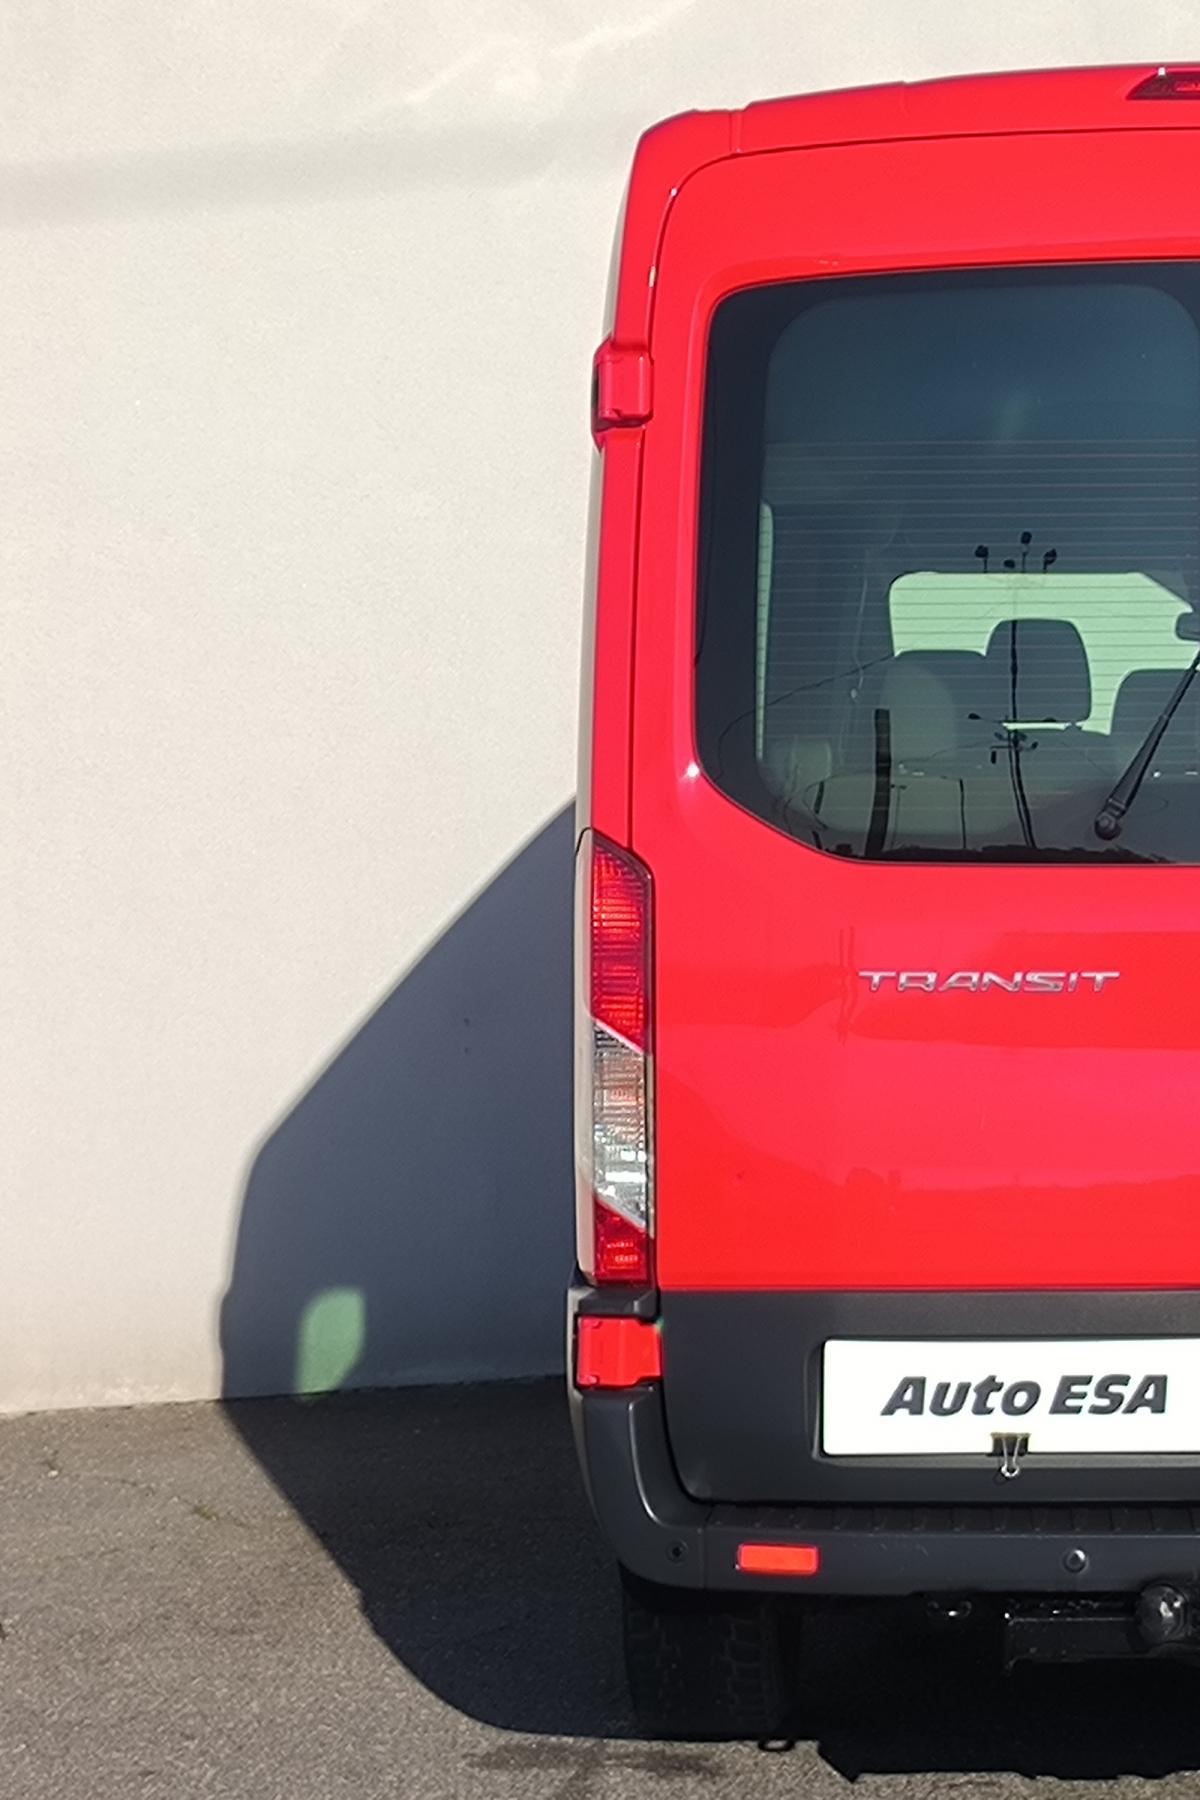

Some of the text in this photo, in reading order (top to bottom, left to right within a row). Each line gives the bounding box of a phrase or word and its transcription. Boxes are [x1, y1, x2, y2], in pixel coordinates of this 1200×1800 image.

[858, 970, 1121, 992] TRANSIT
[880, 1374, 1168, 1416] Auto ESA
